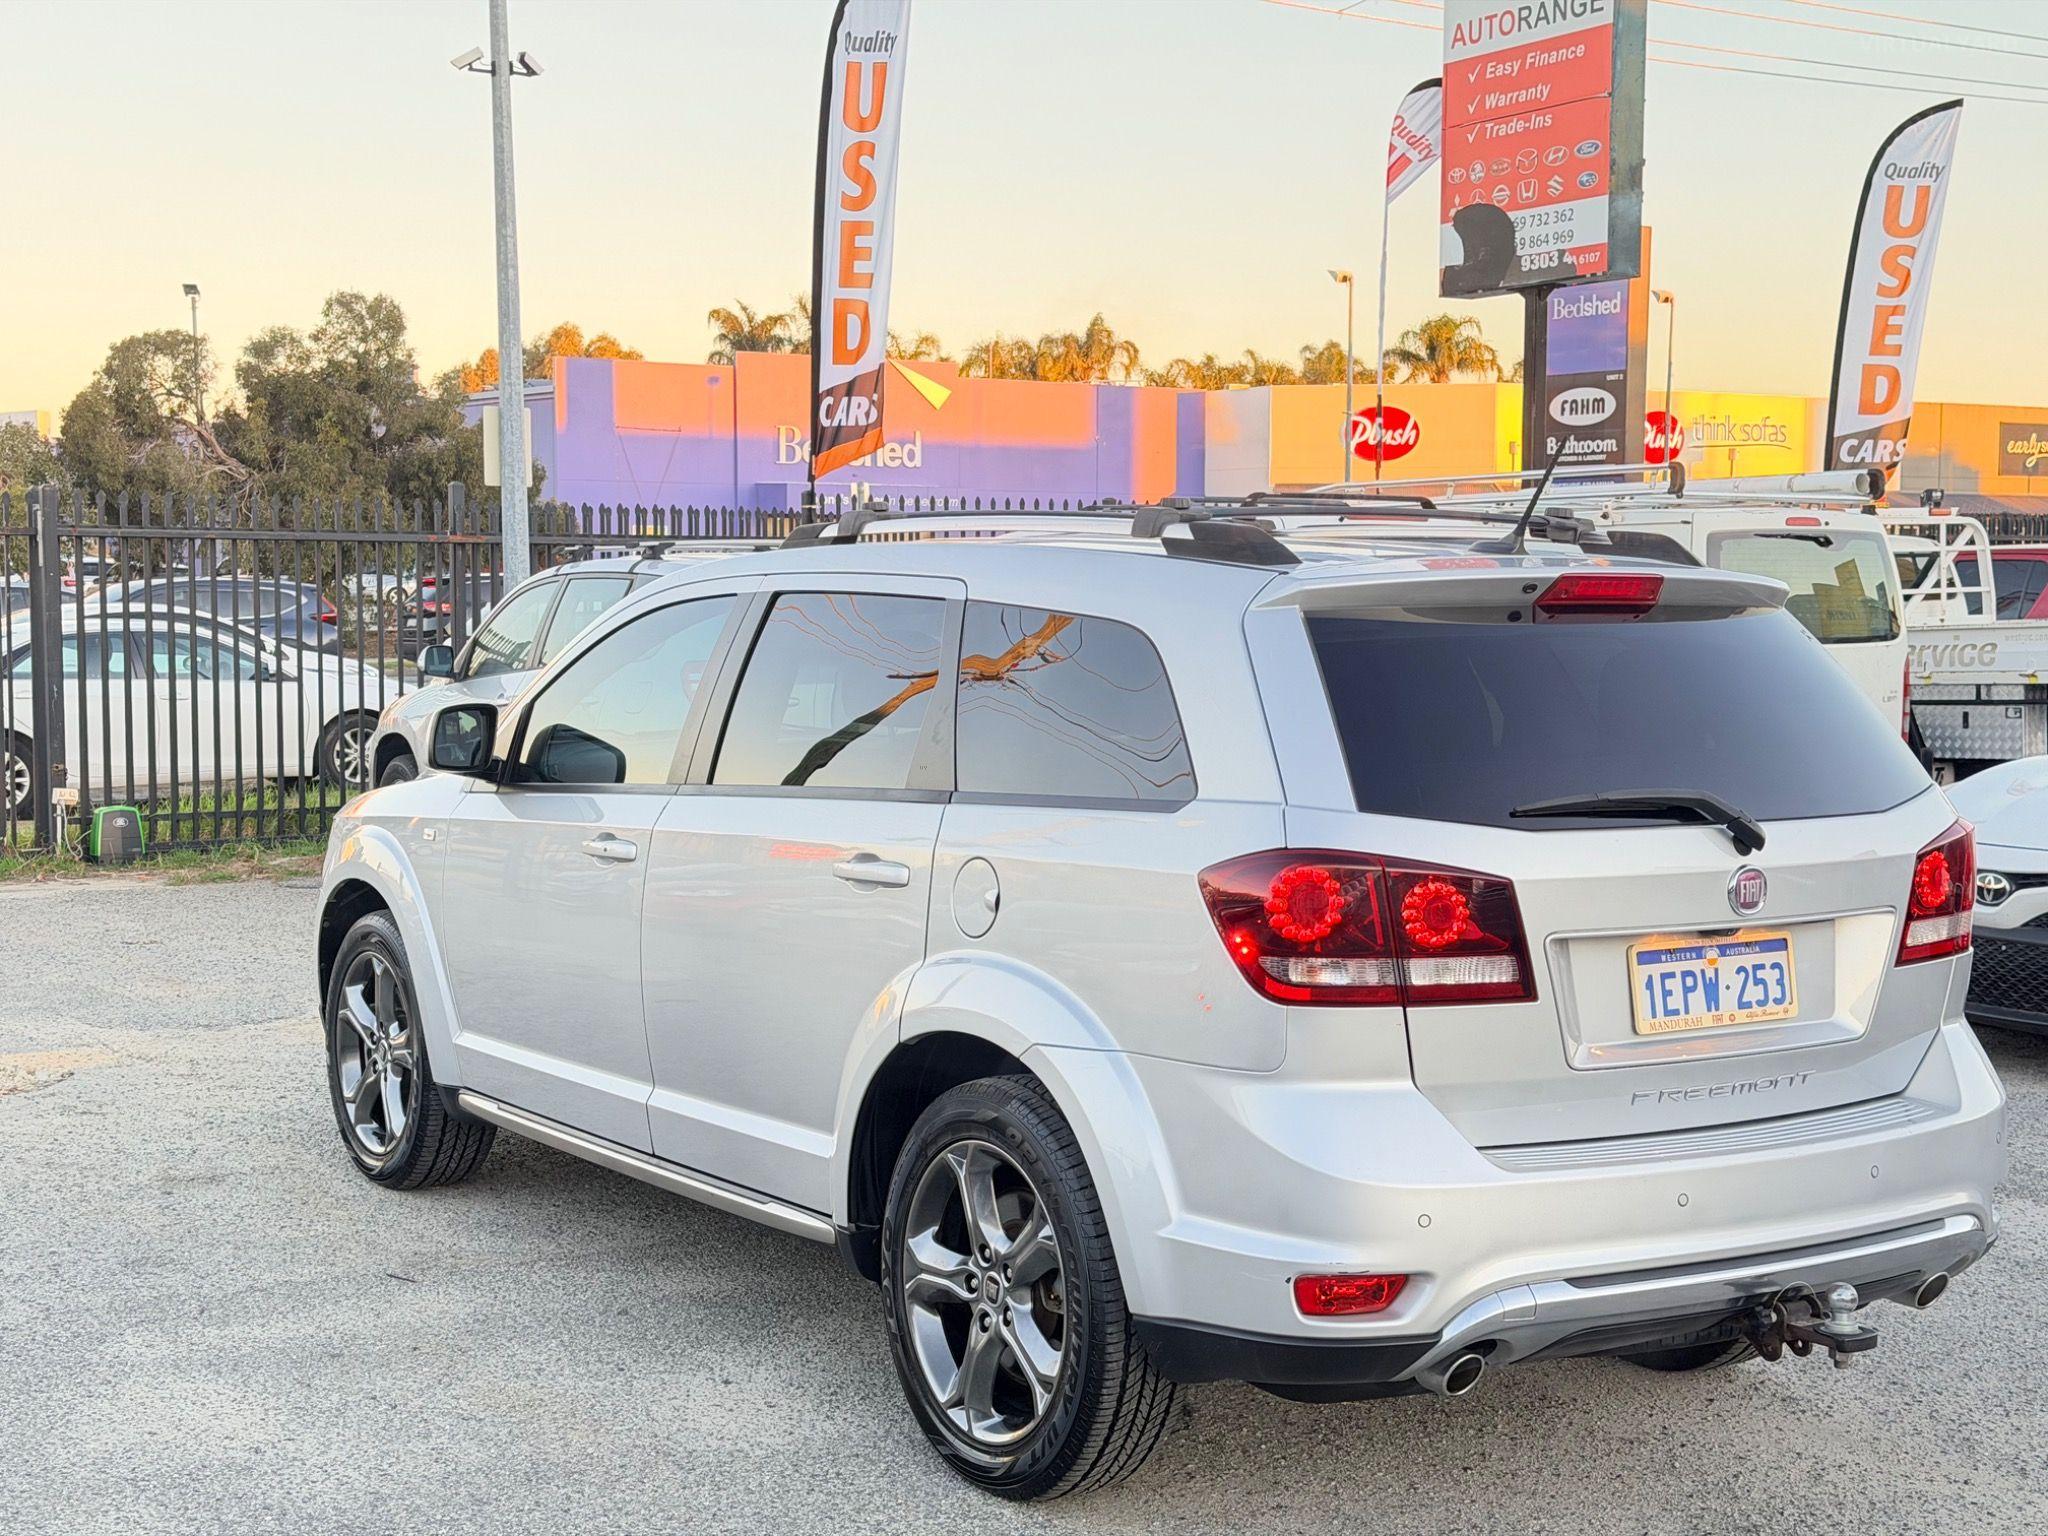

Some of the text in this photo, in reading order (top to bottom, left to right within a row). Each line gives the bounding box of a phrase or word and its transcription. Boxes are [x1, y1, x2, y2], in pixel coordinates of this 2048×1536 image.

[1451, 0, 1605, 50] AUTORANGE
[844, 30, 898, 58] Quality
[1485, 43, 1586, 80] Easy Finance
[1484, 82, 1551, 110] Warranty
[1392, 114, 1438, 163] Quality
[1484, 113, 1552, 140] Trade-Ins
[1884, 161, 1945, 183] Quality
[832, 61, 888, 366] USED
[1529, 212, 1550, 228] 732
[1552, 207, 1575, 224] 362
[1529, 233, 1550, 249] 864
[1552, 228, 1575, 246] 969
[1520, 250, 1559, 271] 9303
[1578, 251, 1601, 264] 6107
[1552, 291, 1621, 320] Bedshed
[1857, 184, 1932, 416] USED
[1560, 396, 1606, 417] FAHM
[1350, 414, 1417, 453] Plush
[1692, 414, 1787, 443] think sofas
[1839, 438, 1908, 463] CARS
[2006, 432, 2048, 468] earlys
[1740, 879, 1761, 903] FIAT
[1661, 944, 1761, 963] WESTERN AUSTRALIA
[1649, 1016, 1704, 1033] MANDURAH
[1631, 1069, 1816, 1106] FREEMONT
